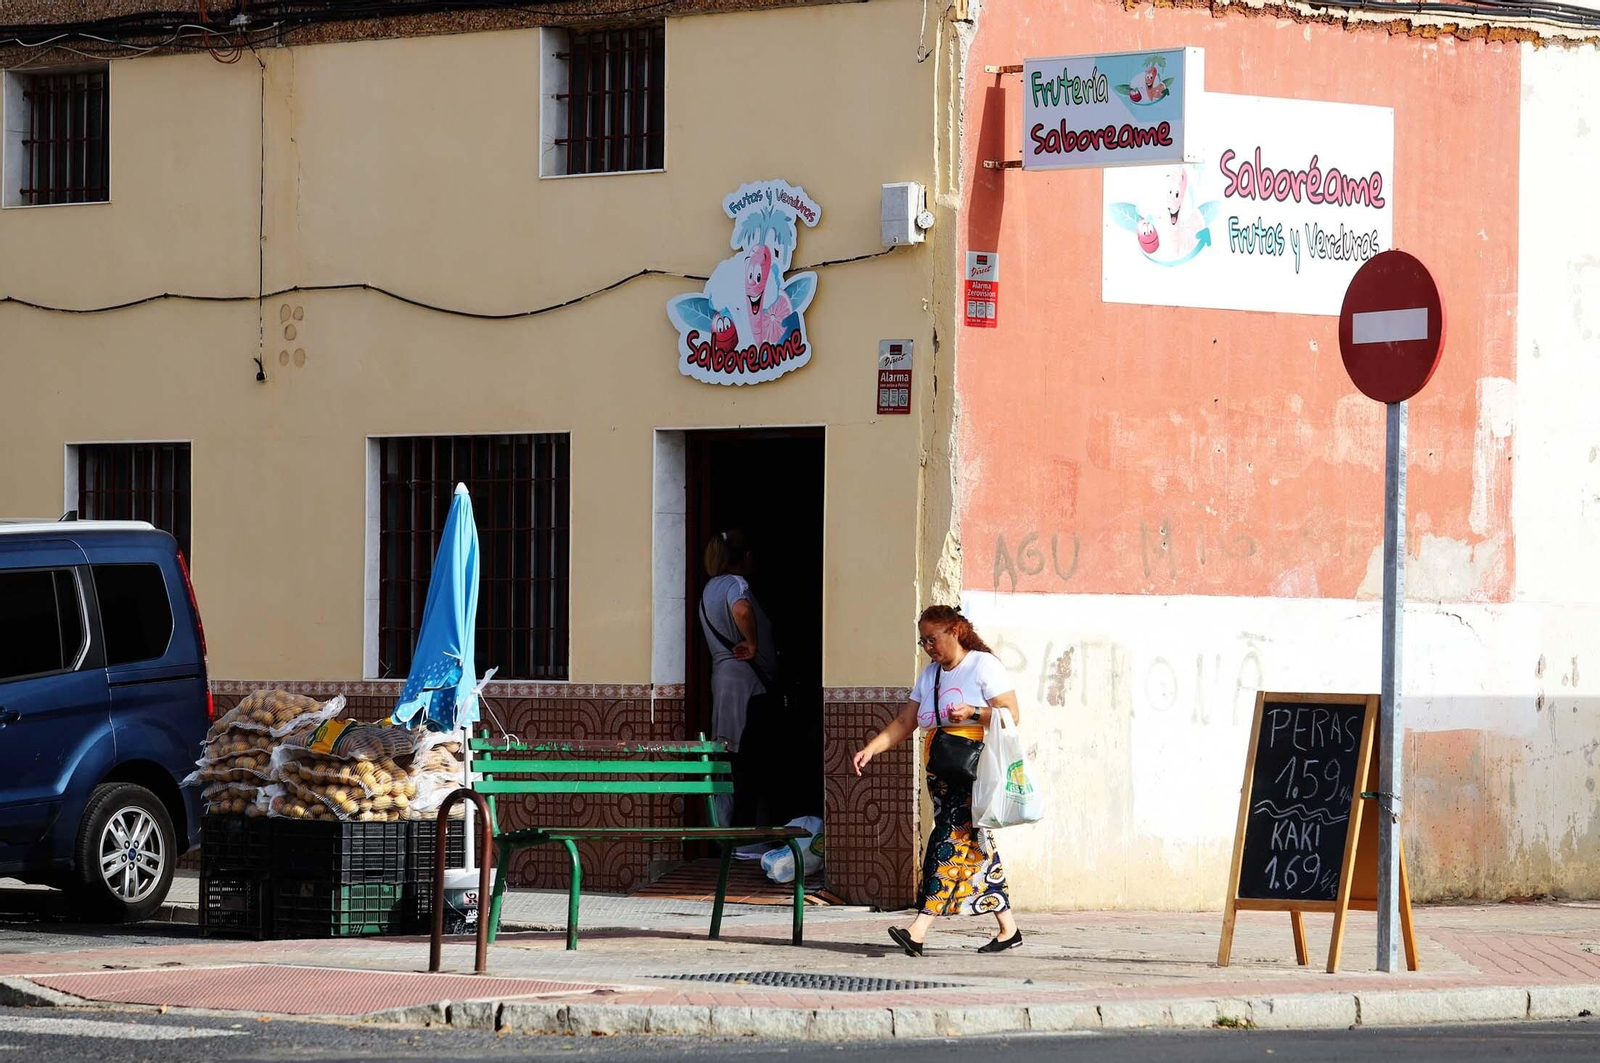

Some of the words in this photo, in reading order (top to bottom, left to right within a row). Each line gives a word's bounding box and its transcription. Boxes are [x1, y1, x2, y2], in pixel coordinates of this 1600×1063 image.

[1031, 66, 1109, 108] Frutería
[1030, 118, 1173, 155] Saboreame
[1220, 146, 1385, 209] Saboréame
[729, 189, 763, 214] Frutas
[765, 187, 773, 206] y
[776, 188, 816, 222] Verduras
[1228, 216, 1285, 256] Frutas
[1290, 228, 1300, 274] y
[1305, 223, 1380, 262] Verduras
[972, 281, 992, 290] Alarma
[687, 330, 806, 373] Saboreame
[880, 372, 909, 382] Alarma
[1267, 708, 1357, 752] PERAS
[1275, 756, 1341, 801] 1.59
[1265, 853, 1320, 893] 1.69
